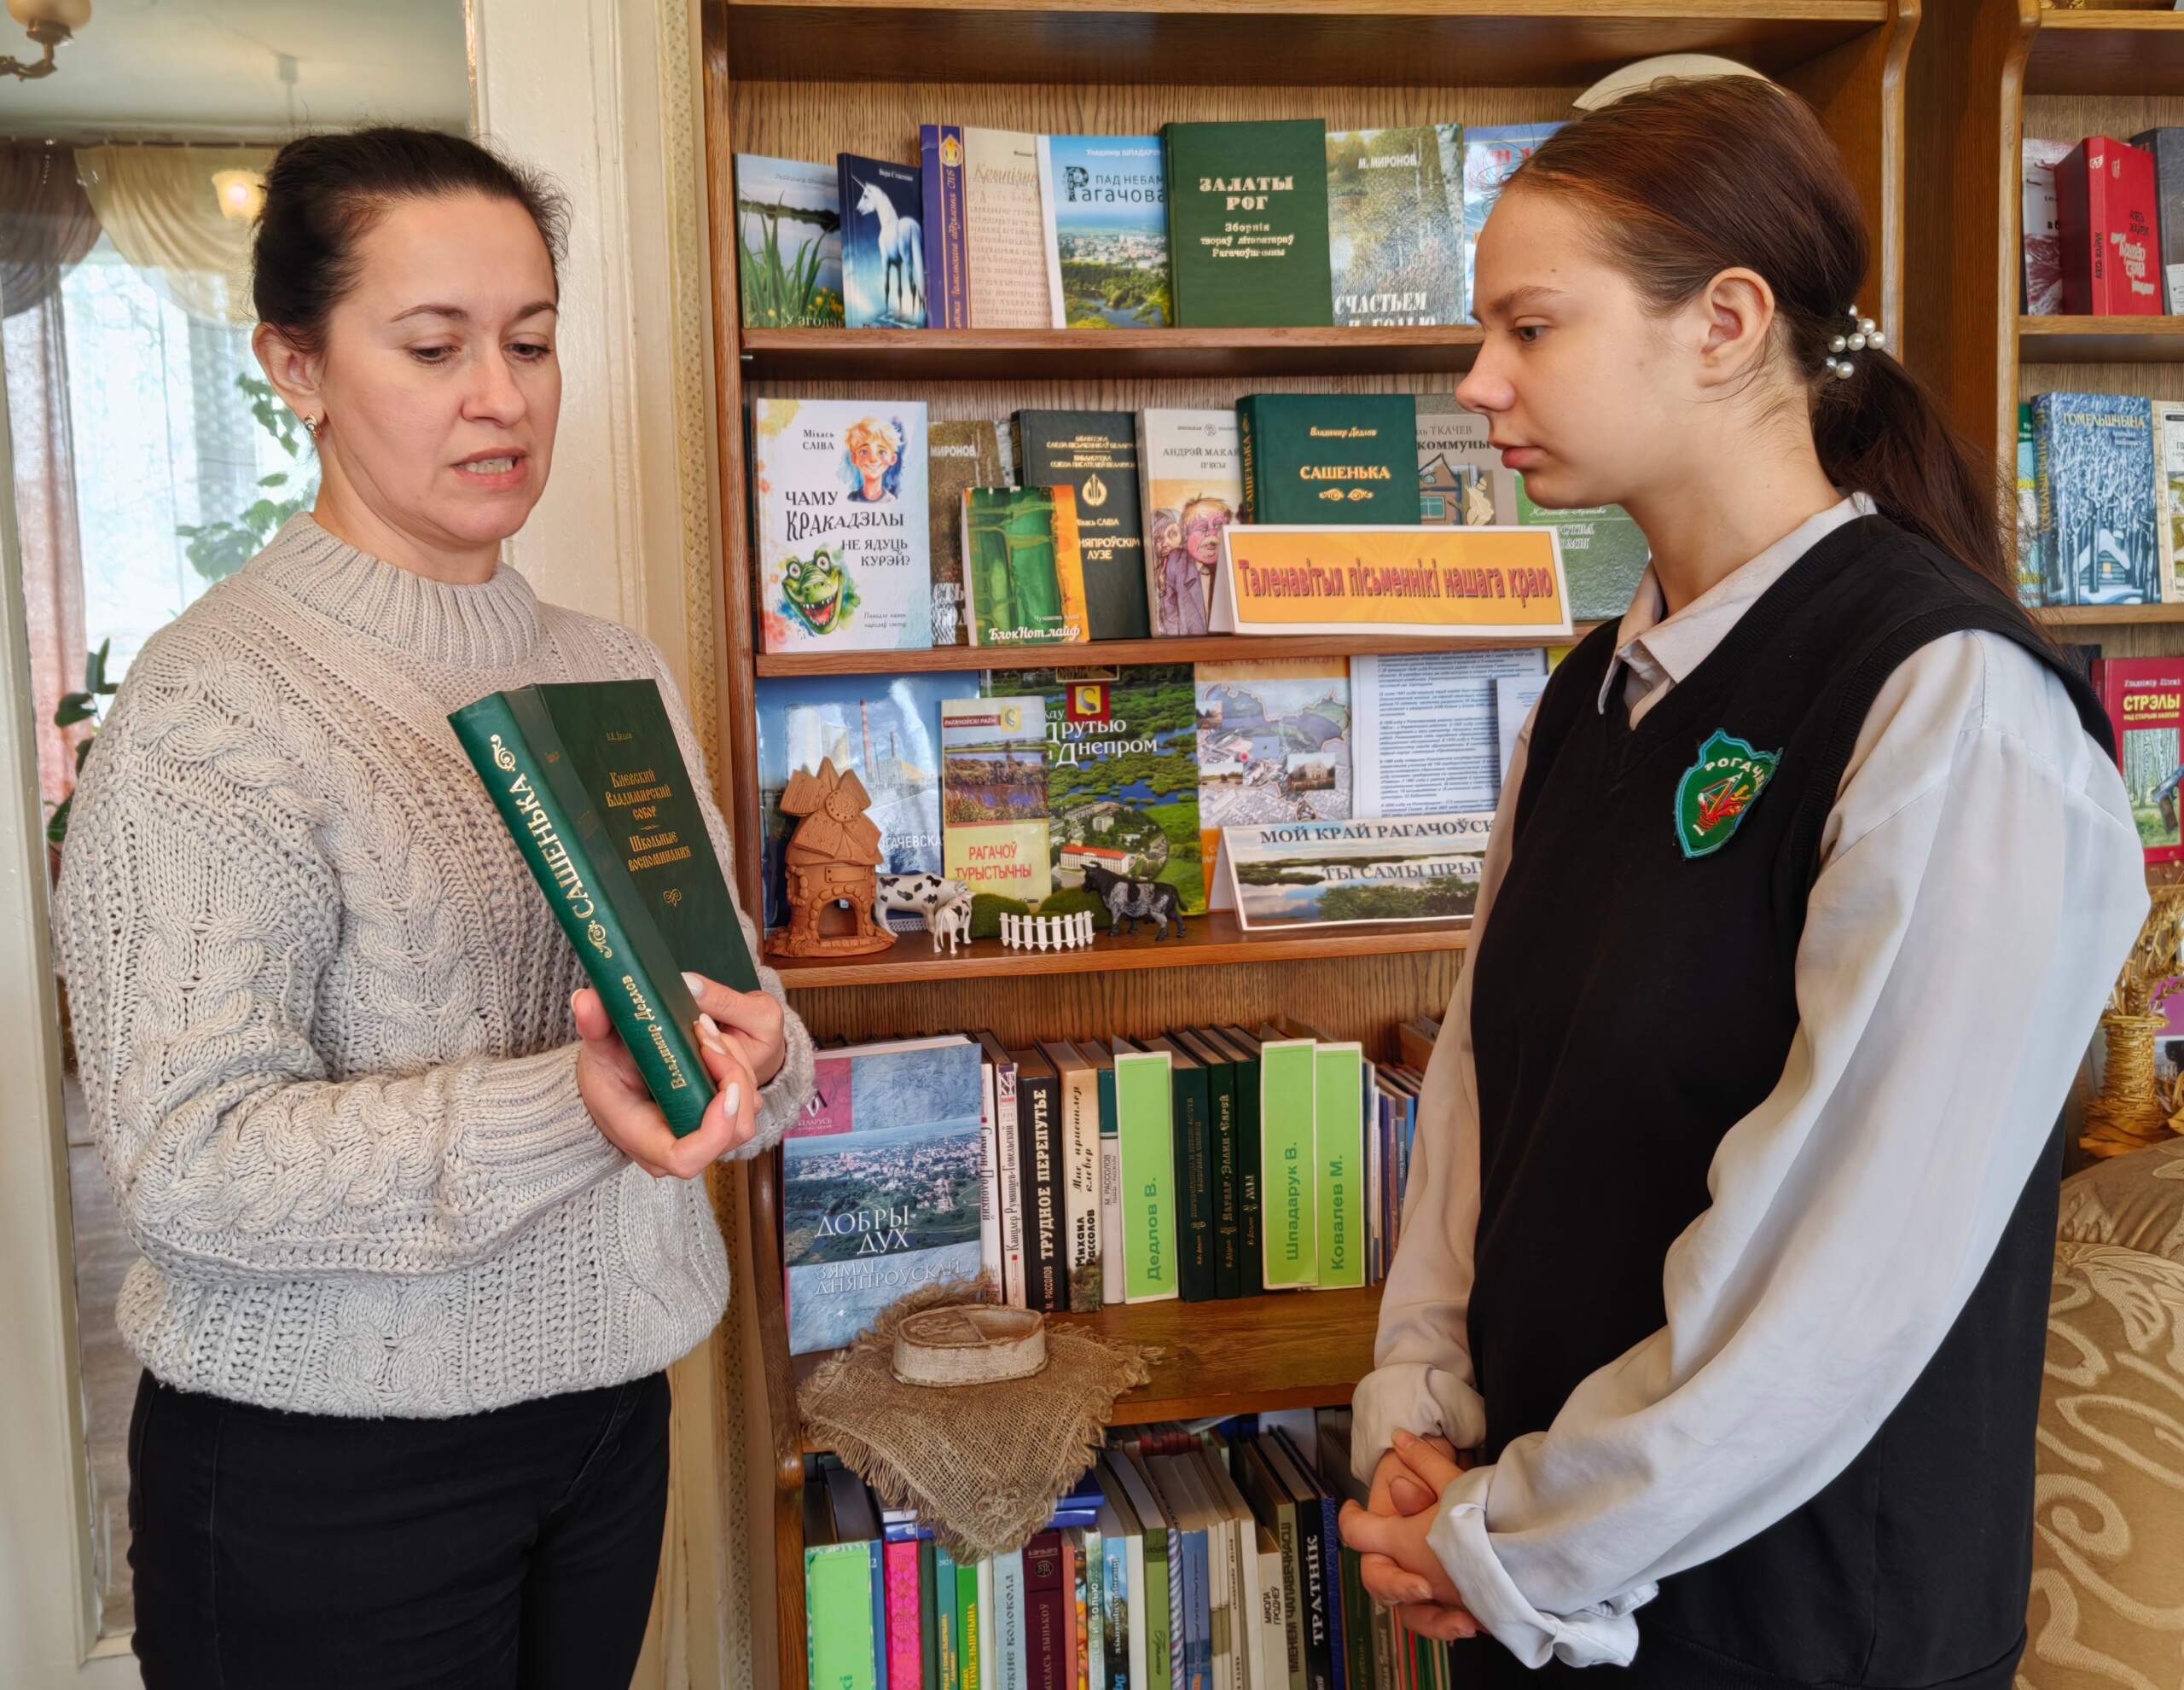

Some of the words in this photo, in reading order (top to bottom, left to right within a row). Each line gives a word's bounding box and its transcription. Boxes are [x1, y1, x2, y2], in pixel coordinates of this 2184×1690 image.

[1358, 157, 1369, 170] М.
[1370, 153, 1418, 169] МИРОНОВ
[1064, 165, 1166, 203] Рагачова
[1095, 174, 1121, 186] ПАД
[1124, 173, 1165, 186] НЕБАМ
[1199, 176, 1294, 193] ЗАЛАТЫ
[1226, 195, 1269, 211] РОГ
[1224, 222, 1270, 233] Зборнік
[1333, 291, 1428, 316] СЧАСТЬЕМ
[803, 429, 835, 438] Міхась
[1429, 425, 1473, 436] ТКАЧЕВ
[803, 441, 835, 450] СЛІВА
[1163, 447, 1203, 457] АНДРЭЙ
[1417, 439, 1490, 453] коммуны
[1299, 466, 1391, 480] САШЕНЬКА
[785, 491, 839, 506] ЧАМУ
[785, 510, 904, 542] КРАКАДЗІЛЫ
[841, 539, 861, 551] НЕ
[864, 538, 909, 555] ЯДУЦЬ
[1078, 535, 1140, 548] НЯПРОЎСКІМ
[861, 555, 911, 566] КУРЭЙ?
[1087, 550, 1113, 560] ЛУЗЕ
[1238, 557, 1344, 598] Таленавітыя
[1347, 557, 1441, 598] пісьменнікі
[1443, 566, 1506, 598] нашага
[1507, 566, 1554, 608] краю
[2123, 694, 2181, 712] СТРЭЛЫ
[1055, 738, 1158, 768] Днепром
[879, 833, 943, 851] ОГАЧЕВСКА
[1259, 827, 1310, 845] МОЙ
[1315, 823, 1372, 840] КРАЙ
[1377, 819, 1494, 839] РАГАЧОЎСК
[508, 771, 595, 920] САШЕНЬКА
[968, 841, 1018, 861] РАГАЧОЎ
[955, 862, 1032, 881] ТУРЫСТЫЧНЫ
[1322, 867, 1355, 880] ТЫ
[1360, 864, 1424, 880] САМЫ
[622, 974, 656, 1023] Дедлов
[644, 1024, 688, 1091] Владимир
[1033, 1089, 1051, 1182] ПЕРЕПУТЬЕ
[1284, 1141, 1298, 1160] В.
[1329, 1154, 1344, 1178] М.
[1071, 1164, 1083, 1193] Мне
[1144, 1176, 1158, 1198] В.
[814, 1205, 910, 1238] ДОБРЫ
[1038, 1187, 1054, 1260] ТРУДНОЕ
[1285, 1164, 1301, 1263] Шпадарук
[1005, 1216, 1021, 1252] Канцлер
[1085, 1208, 1096, 1267] Рассолов
[1330, 1183, 1345, 1270] Ковалев
[856, 1228, 909, 1256] ДУХ
[1074, 1215, 1086, 1269] Михаил
[1146, 1200, 1162, 1281] Дедлов
[816, 1259, 875, 1280] ЗЯМЛІ
[1281, 1522, 1297, 1618] ЧАЛАВЕЧНАСЦІ
[1005, 1574, 1015, 1647] КОЛОКОЛА
[1263, 1591, 1272, 1624] МІКОЛА
[1271, 1586, 1281, 1625] ГРОДНЕЎ
[1287, 1622, 1300, 1673] ІМЕНЕМ
